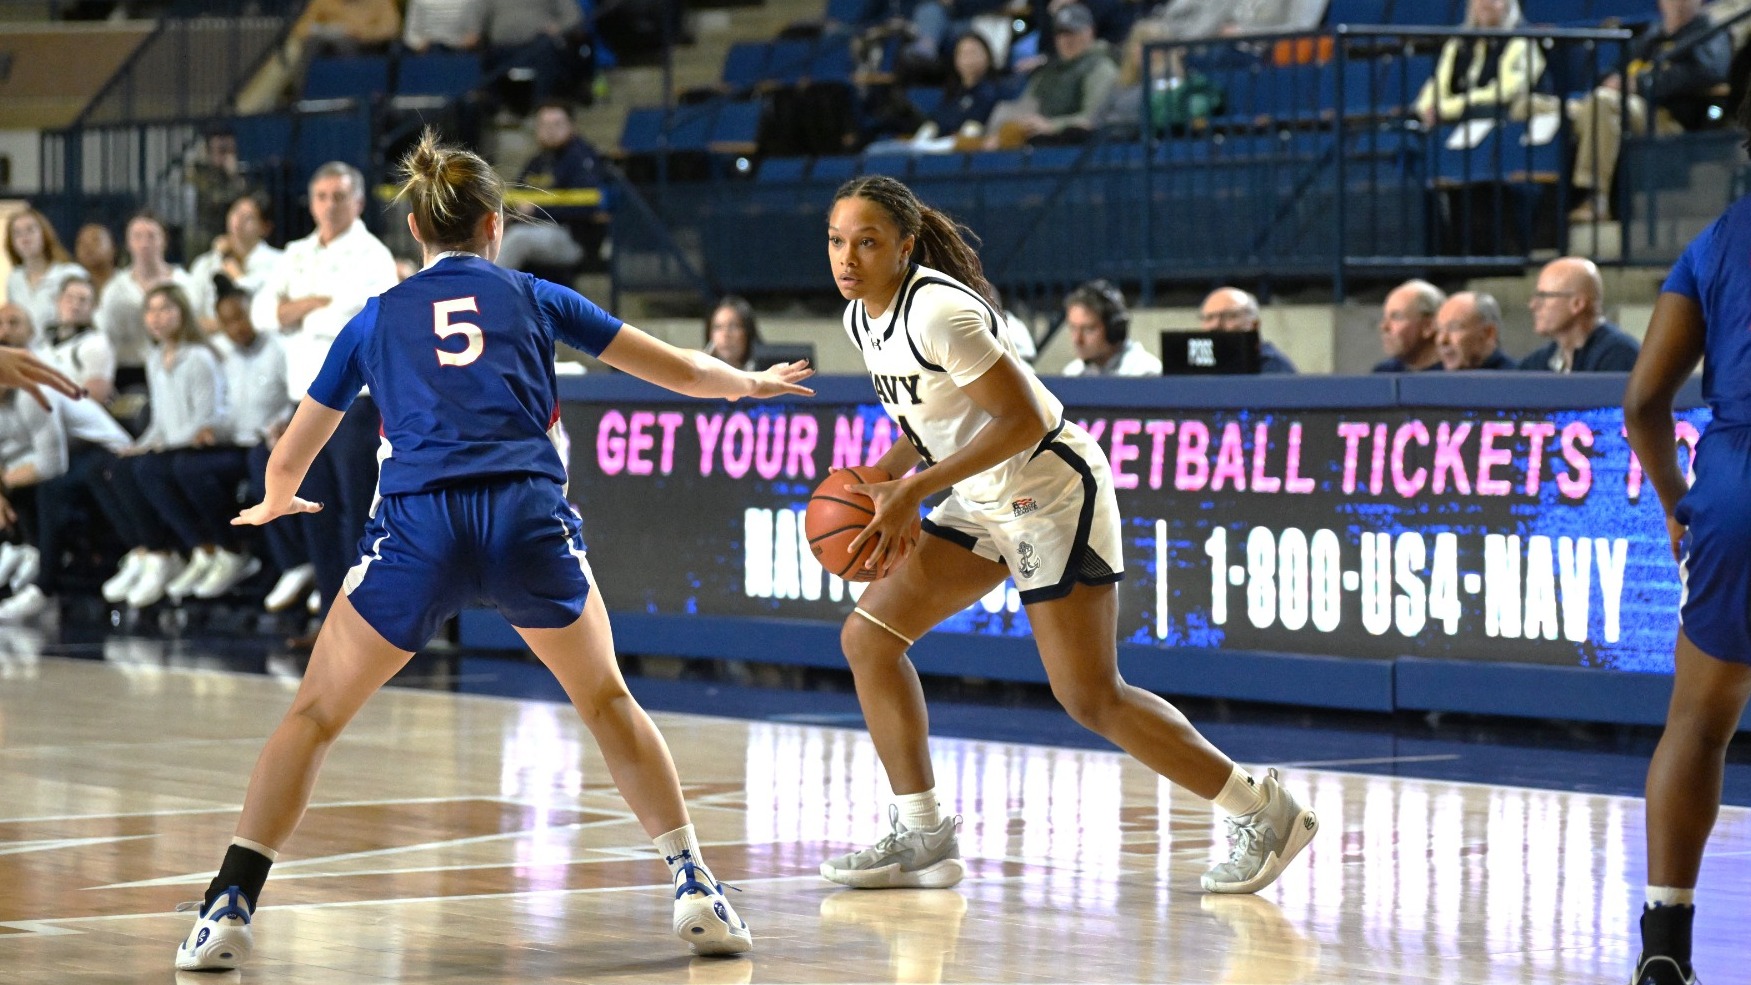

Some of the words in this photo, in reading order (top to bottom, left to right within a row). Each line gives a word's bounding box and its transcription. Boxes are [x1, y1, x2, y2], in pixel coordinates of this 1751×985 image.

[432, 296, 484, 368] 5
[869, 371, 922, 404] AVY
[597, 409, 684, 476] GET
[695, 411, 818, 479] YOUR
[1076, 418, 1316, 494] ETBALL
[1337, 420, 1594, 499] TICKETS
[1205, 526, 1628, 642] 1-800-US4-NAVY
